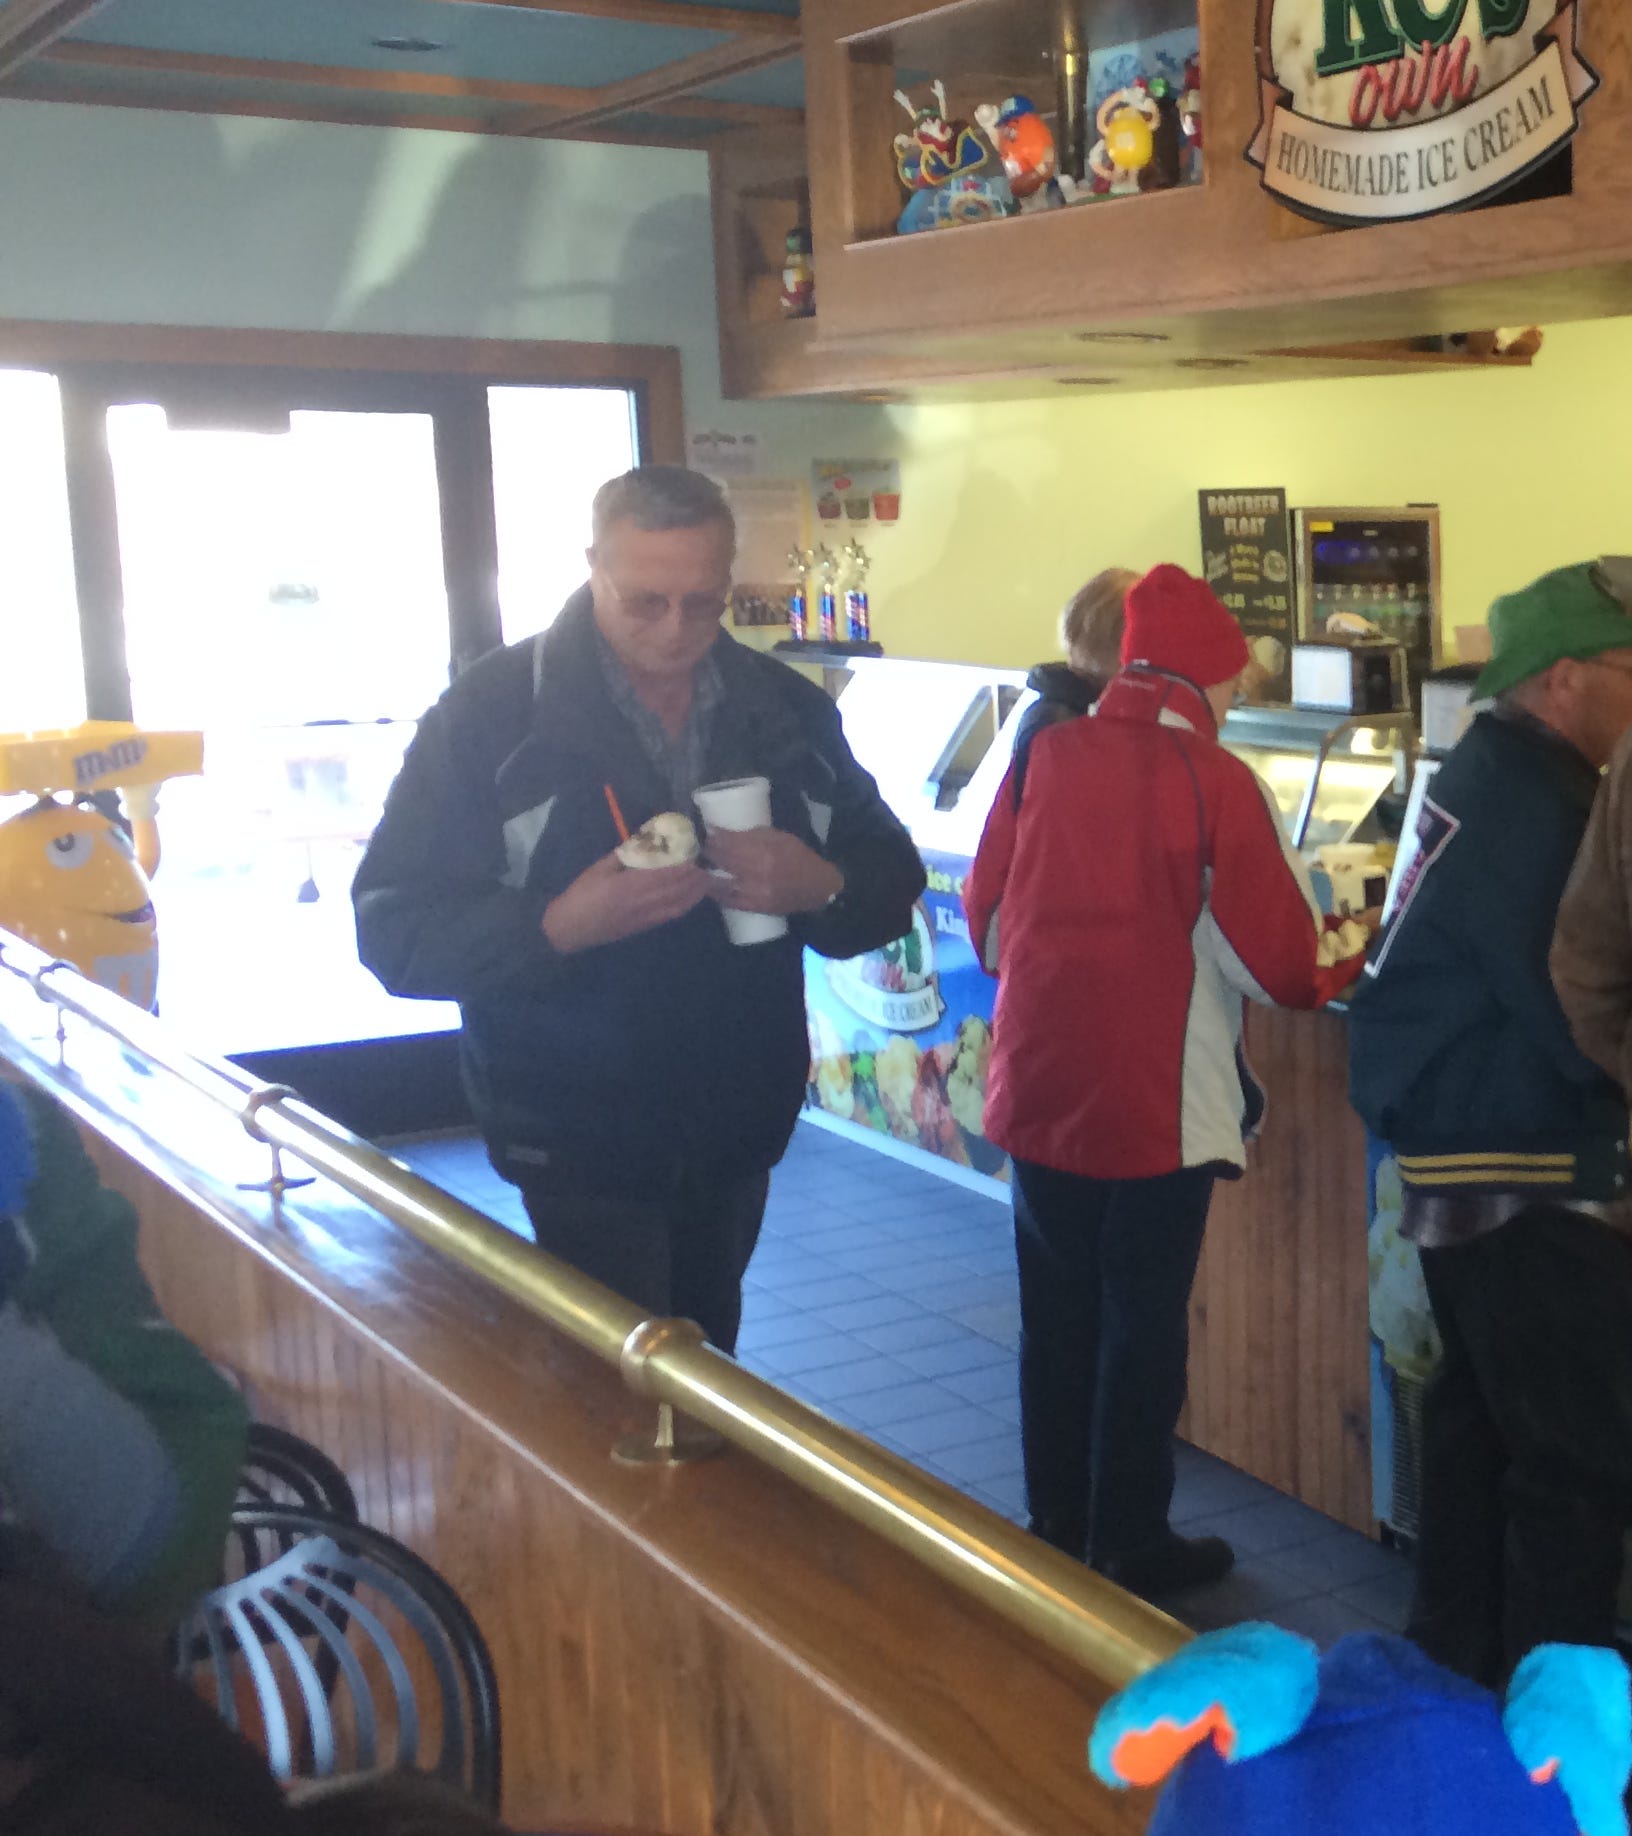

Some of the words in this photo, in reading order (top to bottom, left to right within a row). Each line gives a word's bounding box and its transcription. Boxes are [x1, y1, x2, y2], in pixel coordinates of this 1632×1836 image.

[1276, 131, 1409, 197] HOMEMADE
[1415, 137, 1458, 191] ICE
[1463, 73, 1555, 172] CREAM
[1350, 35, 1479, 128] own
